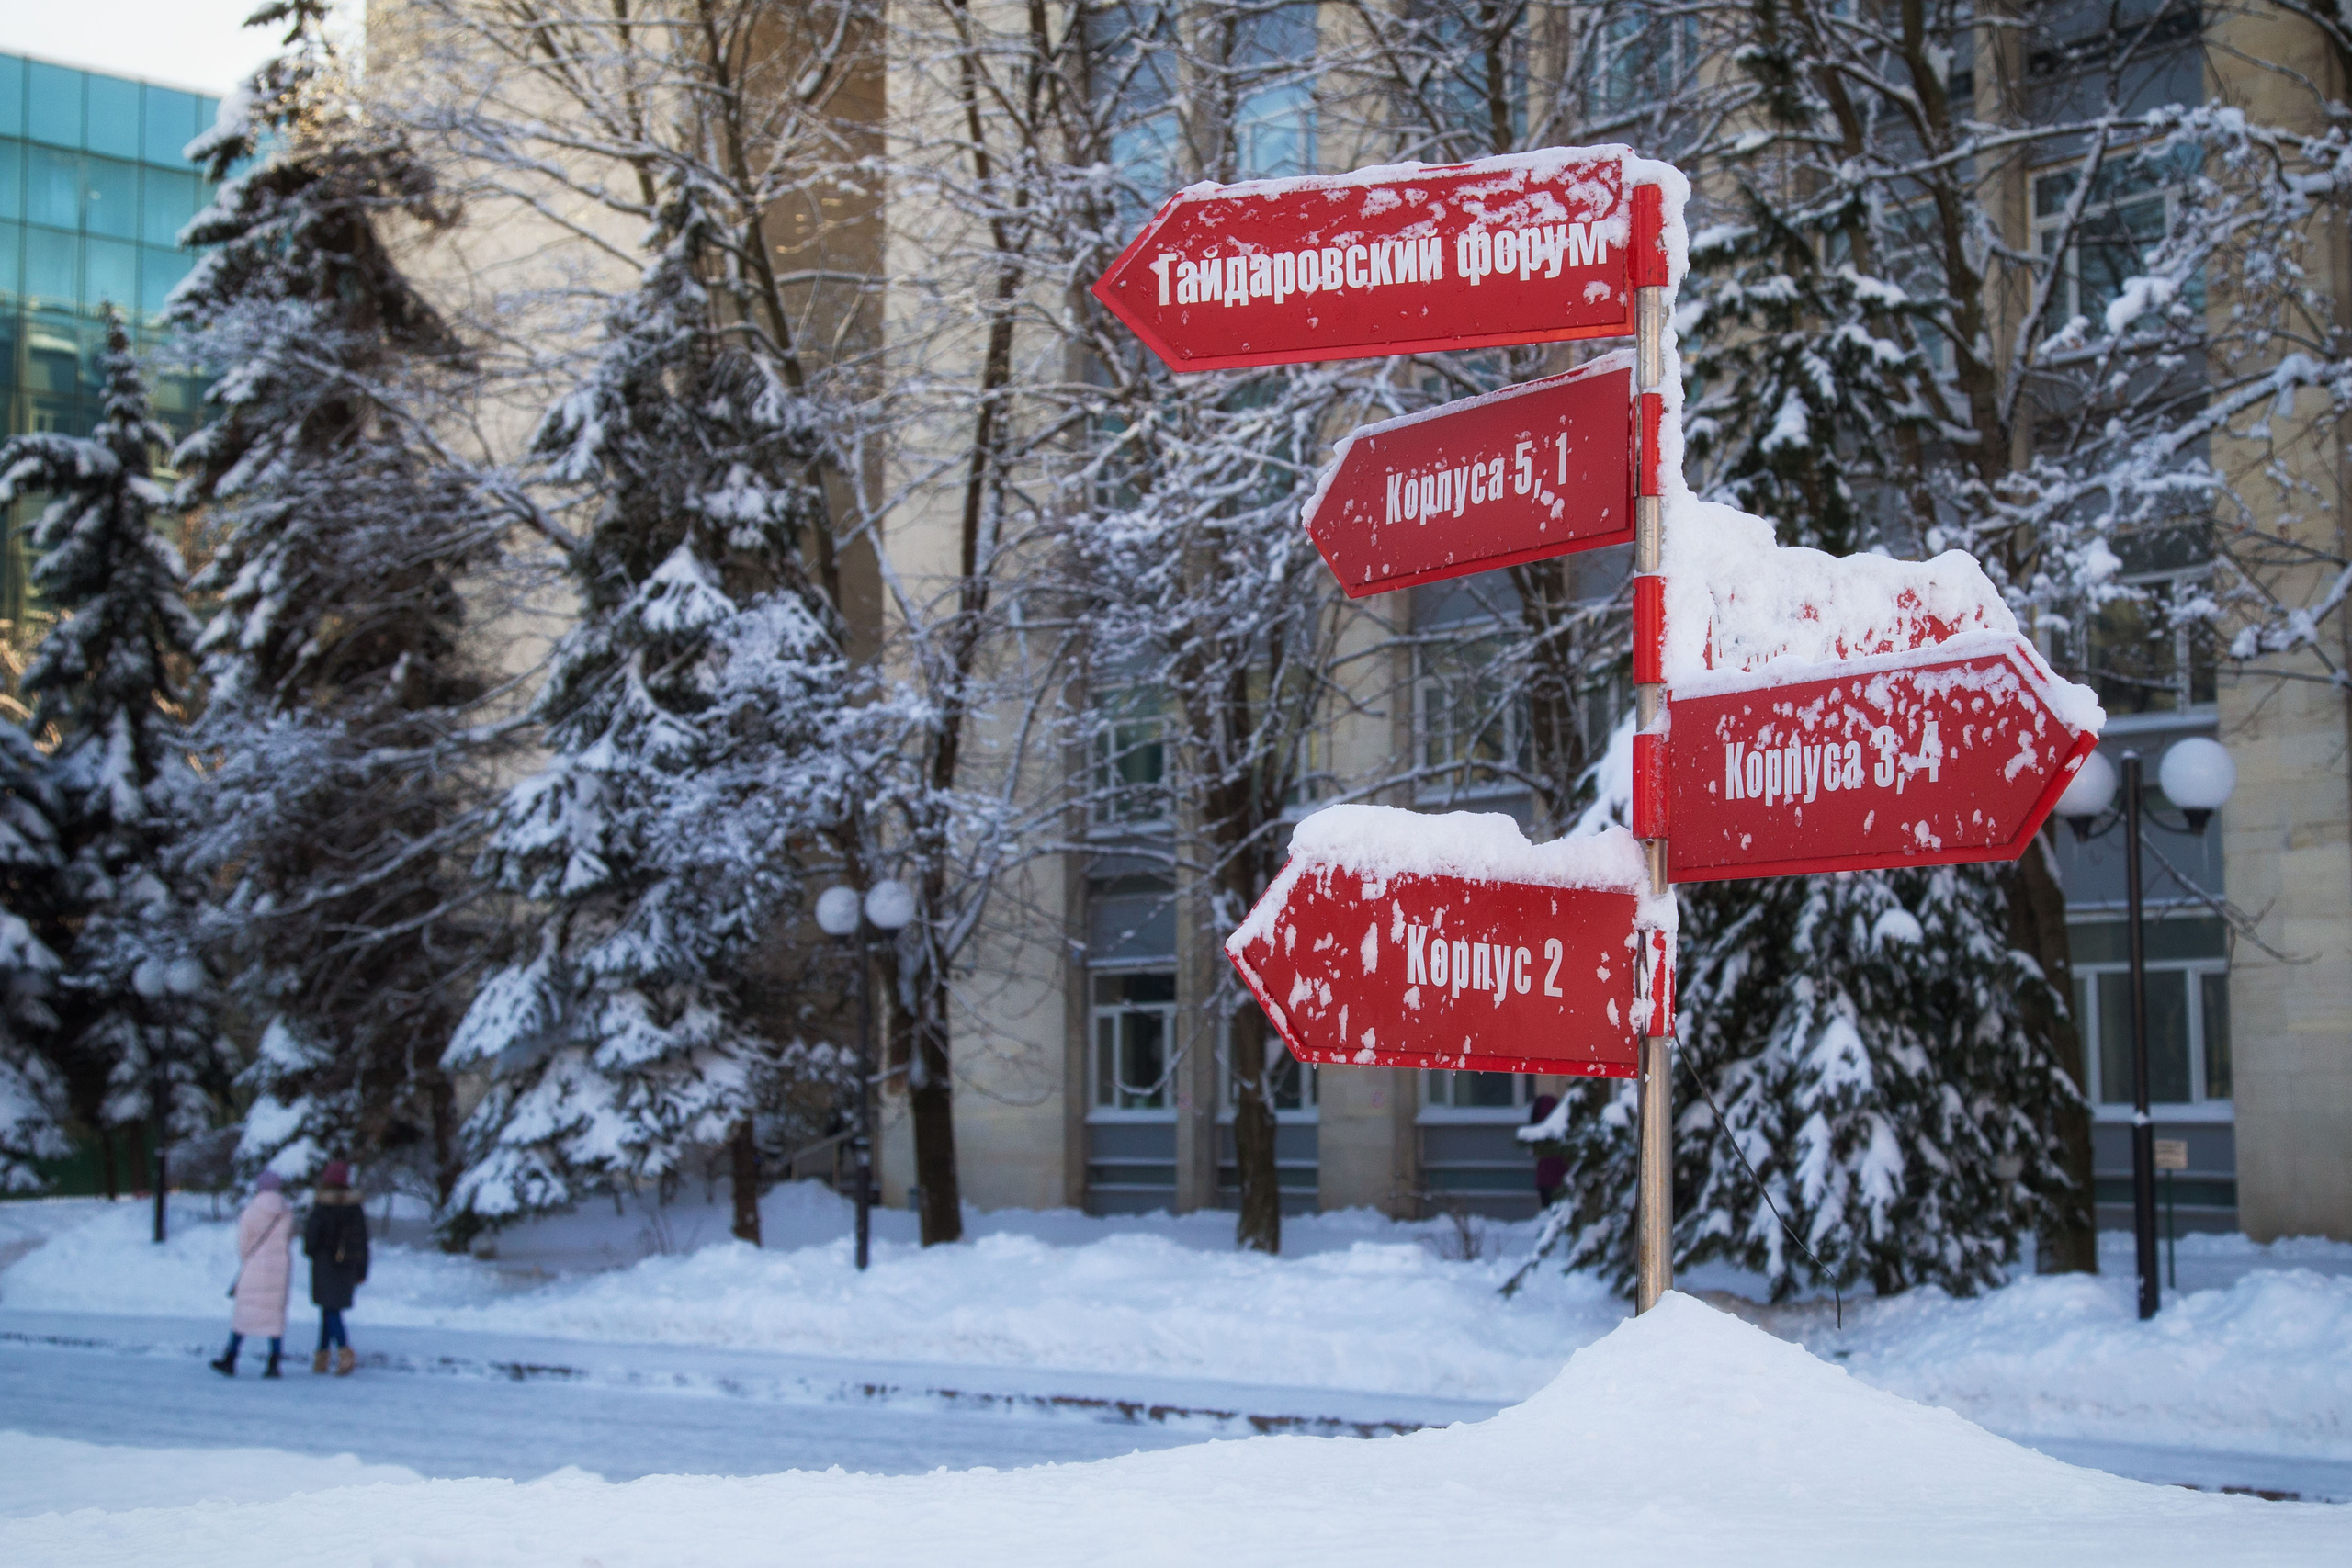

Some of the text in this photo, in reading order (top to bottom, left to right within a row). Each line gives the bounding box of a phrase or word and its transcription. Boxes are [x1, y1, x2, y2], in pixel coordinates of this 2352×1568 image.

[1158, 220, 1608, 308] Гайдаровский форум
[1385, 457, 1504, 526] Корпуса
[1555, 431, 1568, 486] 1
[1725, 739, 1863, 807] Корпуса
[1917, 720, 1941, 783] 4
[1407, 924, 1564, 1002] Корпус 2
